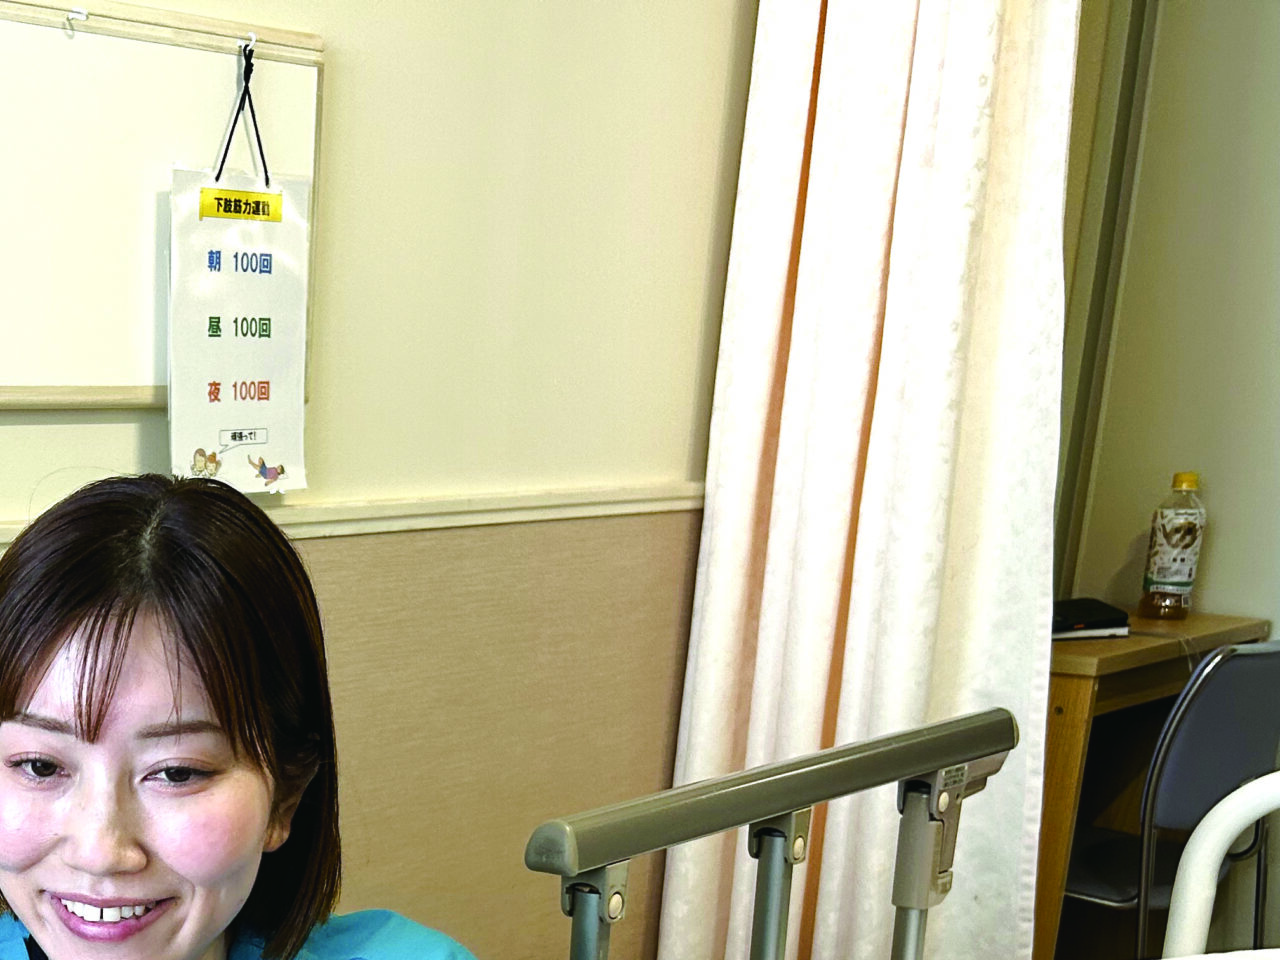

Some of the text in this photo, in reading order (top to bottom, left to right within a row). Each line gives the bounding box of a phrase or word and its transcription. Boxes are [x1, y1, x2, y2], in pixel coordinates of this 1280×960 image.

[208, 250, 272, 274] 朝 100回
[208, 316, 271, 338] 昼 100回
[208, 381, 270, 402] 夜 100回
